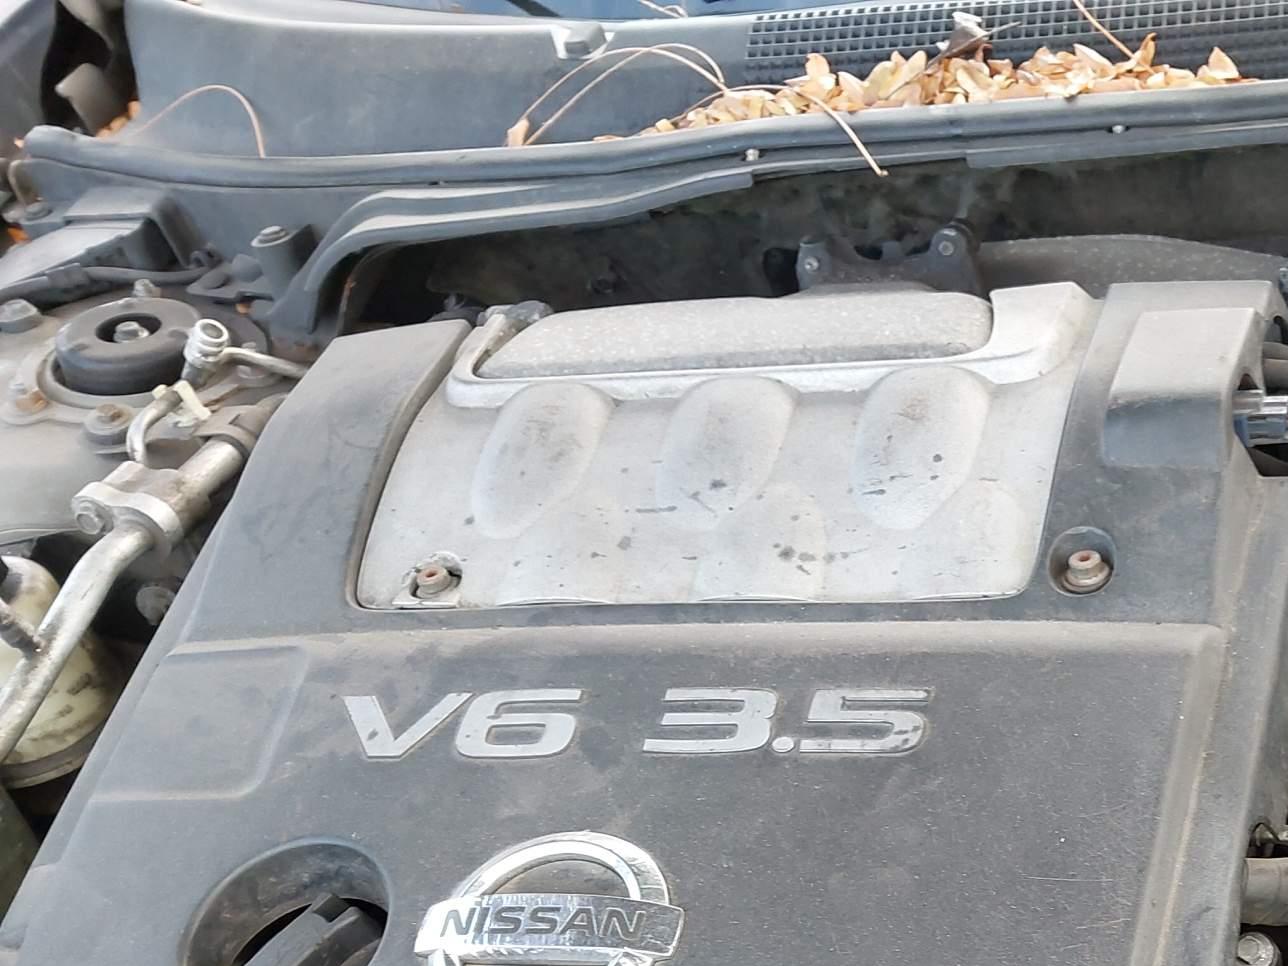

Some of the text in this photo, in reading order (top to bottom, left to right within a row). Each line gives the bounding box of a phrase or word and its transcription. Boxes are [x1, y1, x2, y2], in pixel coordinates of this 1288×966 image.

[344, 687, 931, 759] V6 3.5
[439, 905, 648, 940] NISSAN
